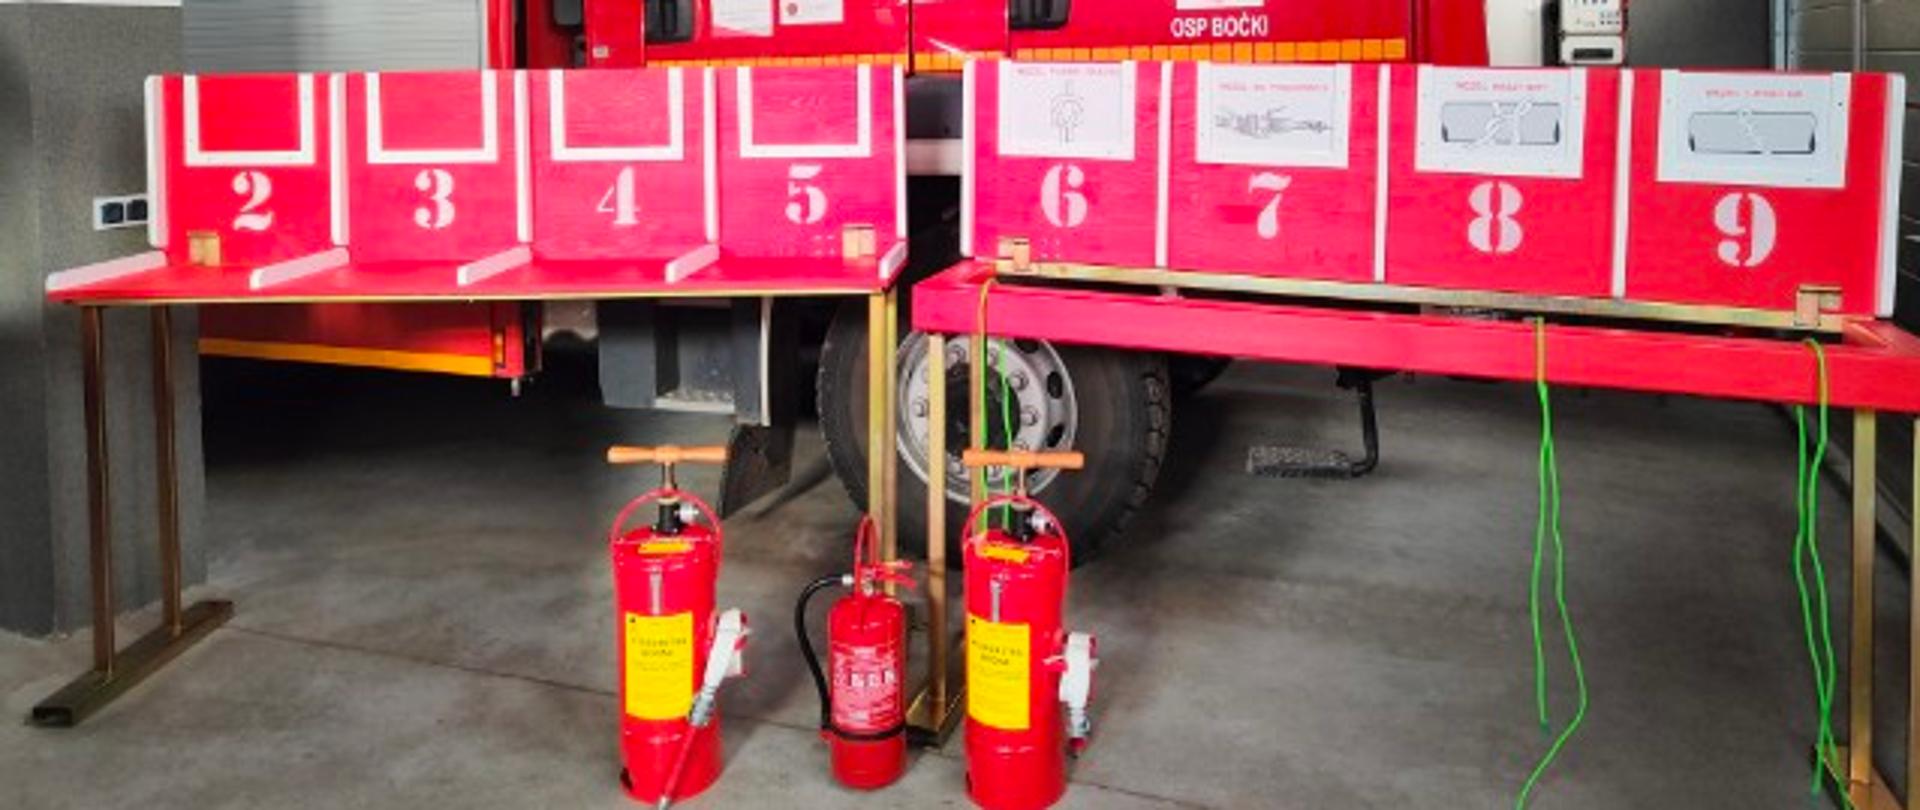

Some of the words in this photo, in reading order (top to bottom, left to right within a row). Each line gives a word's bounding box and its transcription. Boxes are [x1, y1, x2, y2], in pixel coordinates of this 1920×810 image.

[1170, 17, 1207, 37] OSP
[234, 172, 272, 230] 2
[414, 169, 455, 229] 3
[597, 165, 640, 228] 4
[785, 163, 827, 224] 5
[1041, 164, 1087, 228] 6
[1249, 173, 1292, 239] 7
[1468, 182, 1522, 253] 8
[1715, 193, 1776, 267] 9
